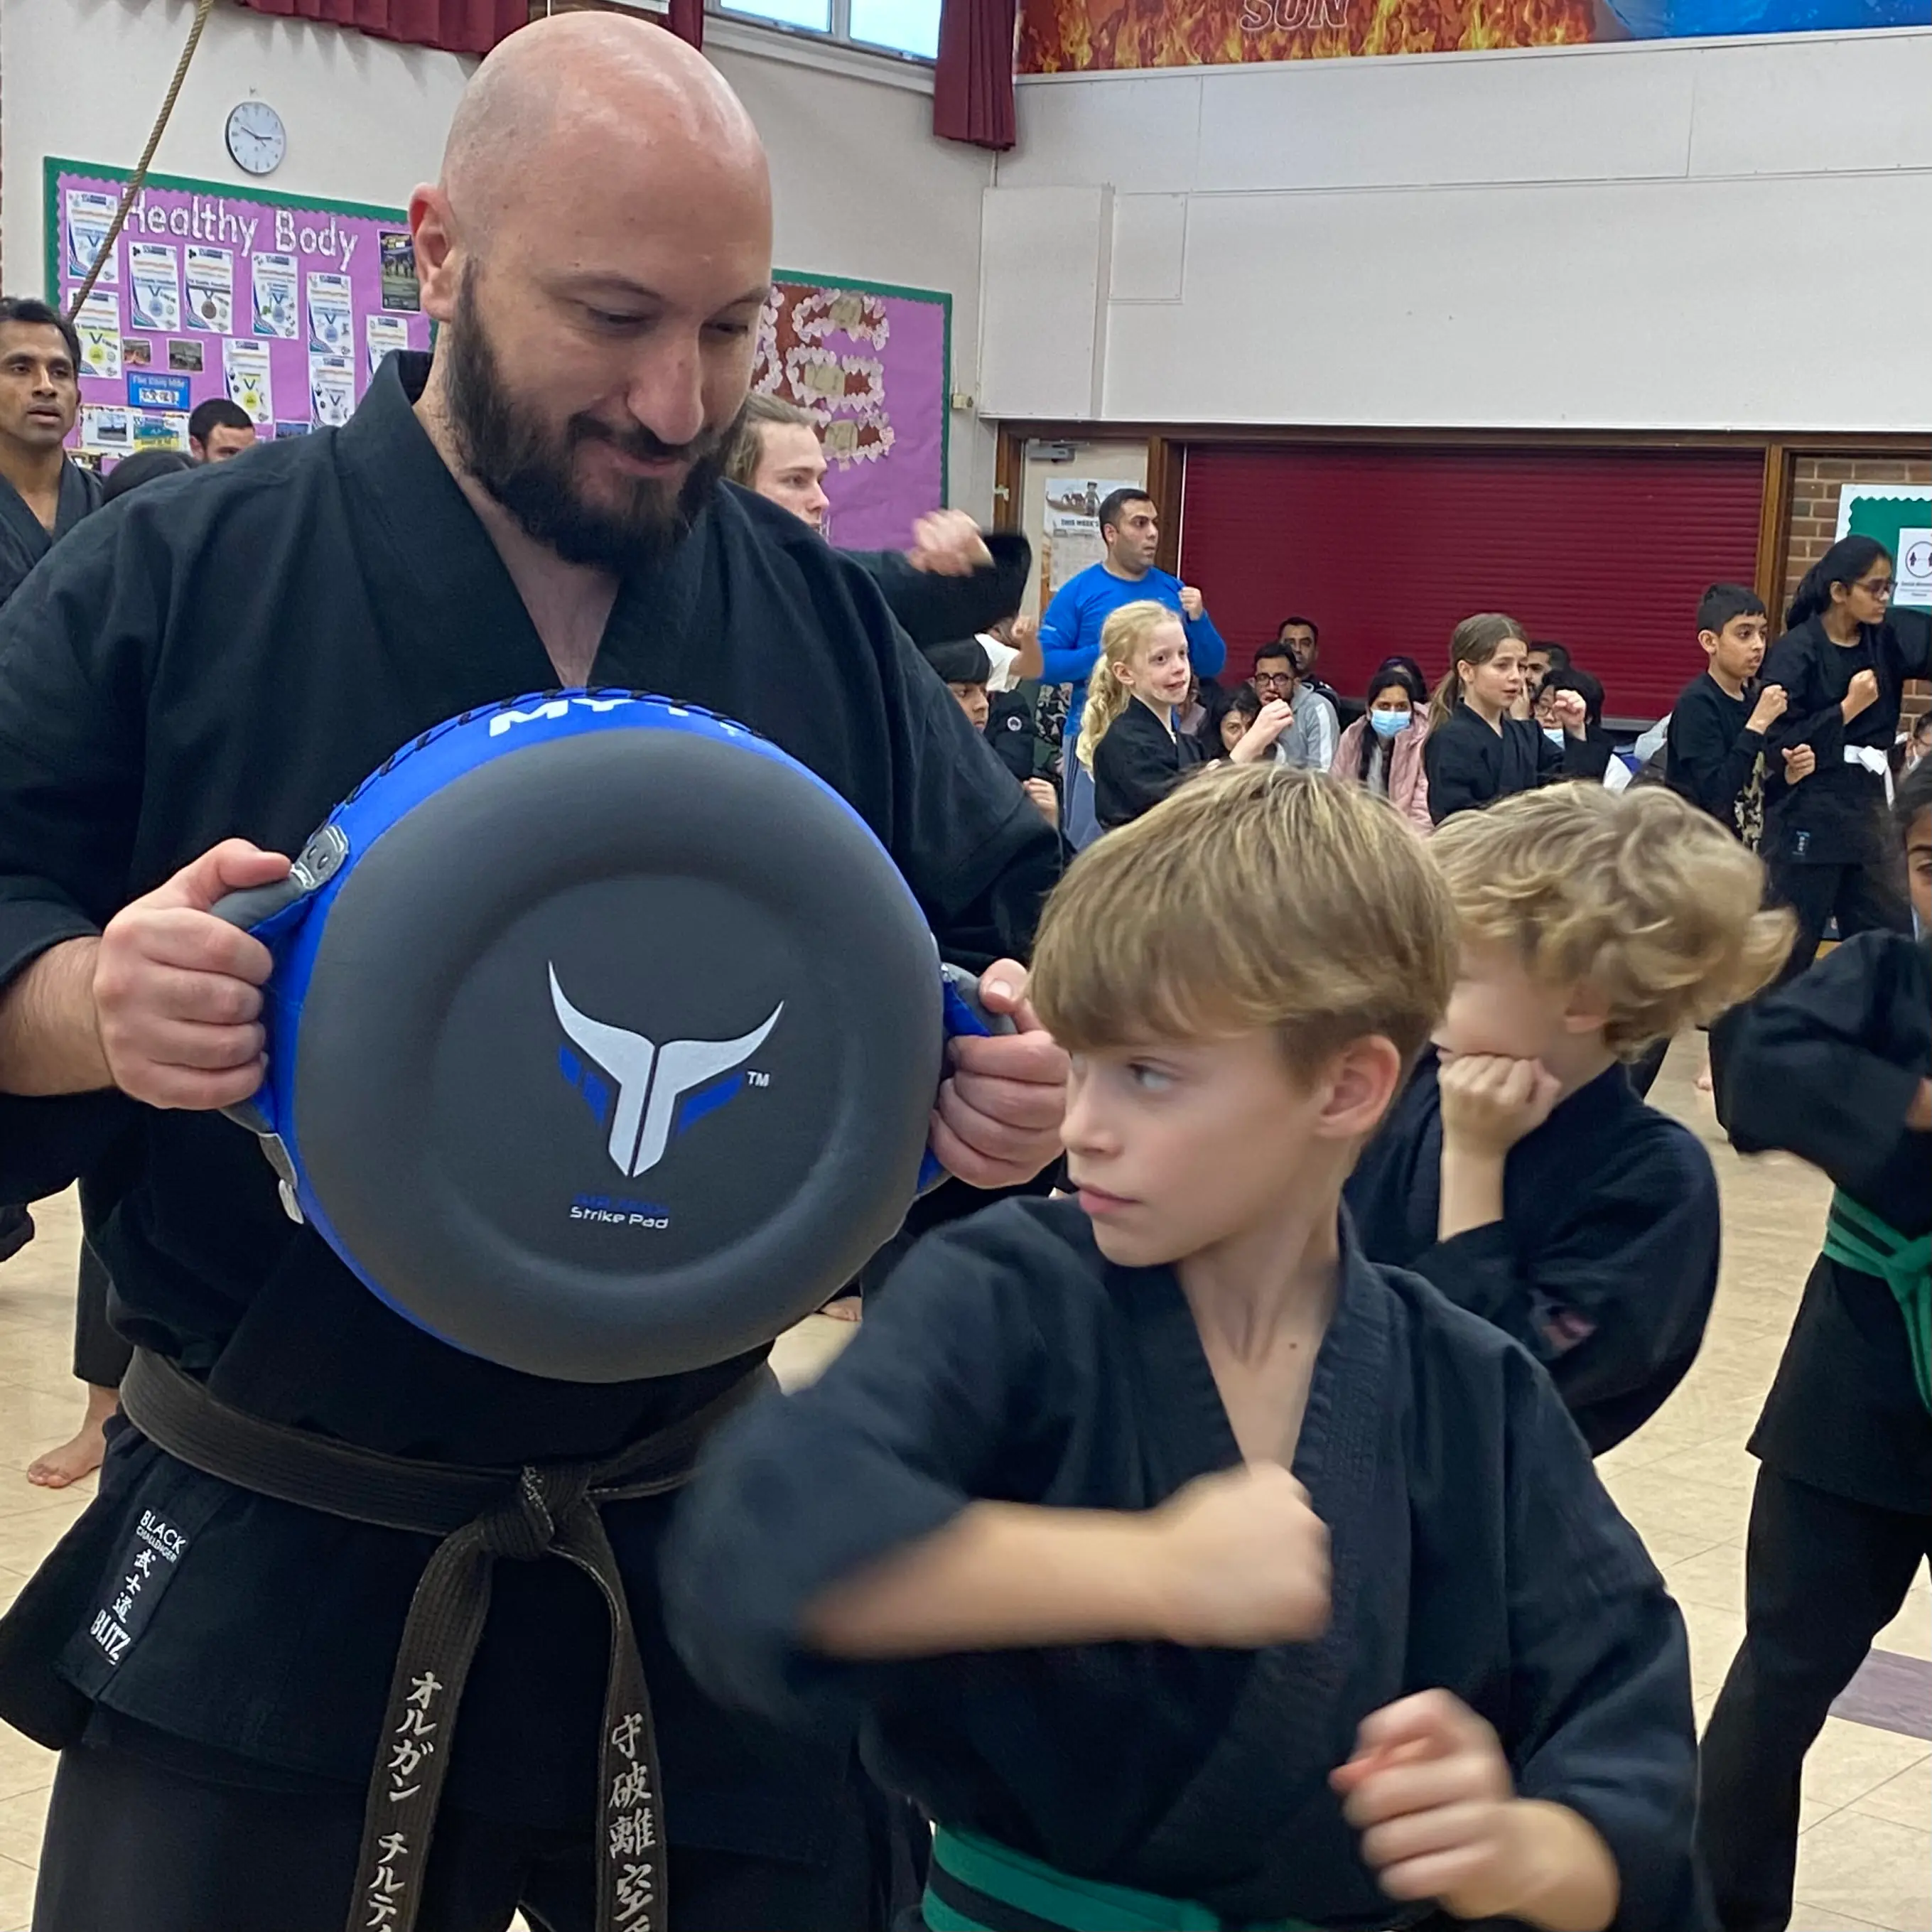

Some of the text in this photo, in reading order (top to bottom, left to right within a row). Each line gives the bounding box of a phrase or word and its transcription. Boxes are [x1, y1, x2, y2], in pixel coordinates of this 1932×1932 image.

[1240, 0, 1349, 31] SUN
[122, 188, 359, 272] Healthy Body
[748, 1071, 770, 1087] TM
[570, 1206, 669, 1229] Strike Pad
[139, 1509, 187, 1555] BLACK
[90, 1609, 131, 1661] BLITZ
[387, 1671, 443, 1802] オルガン
